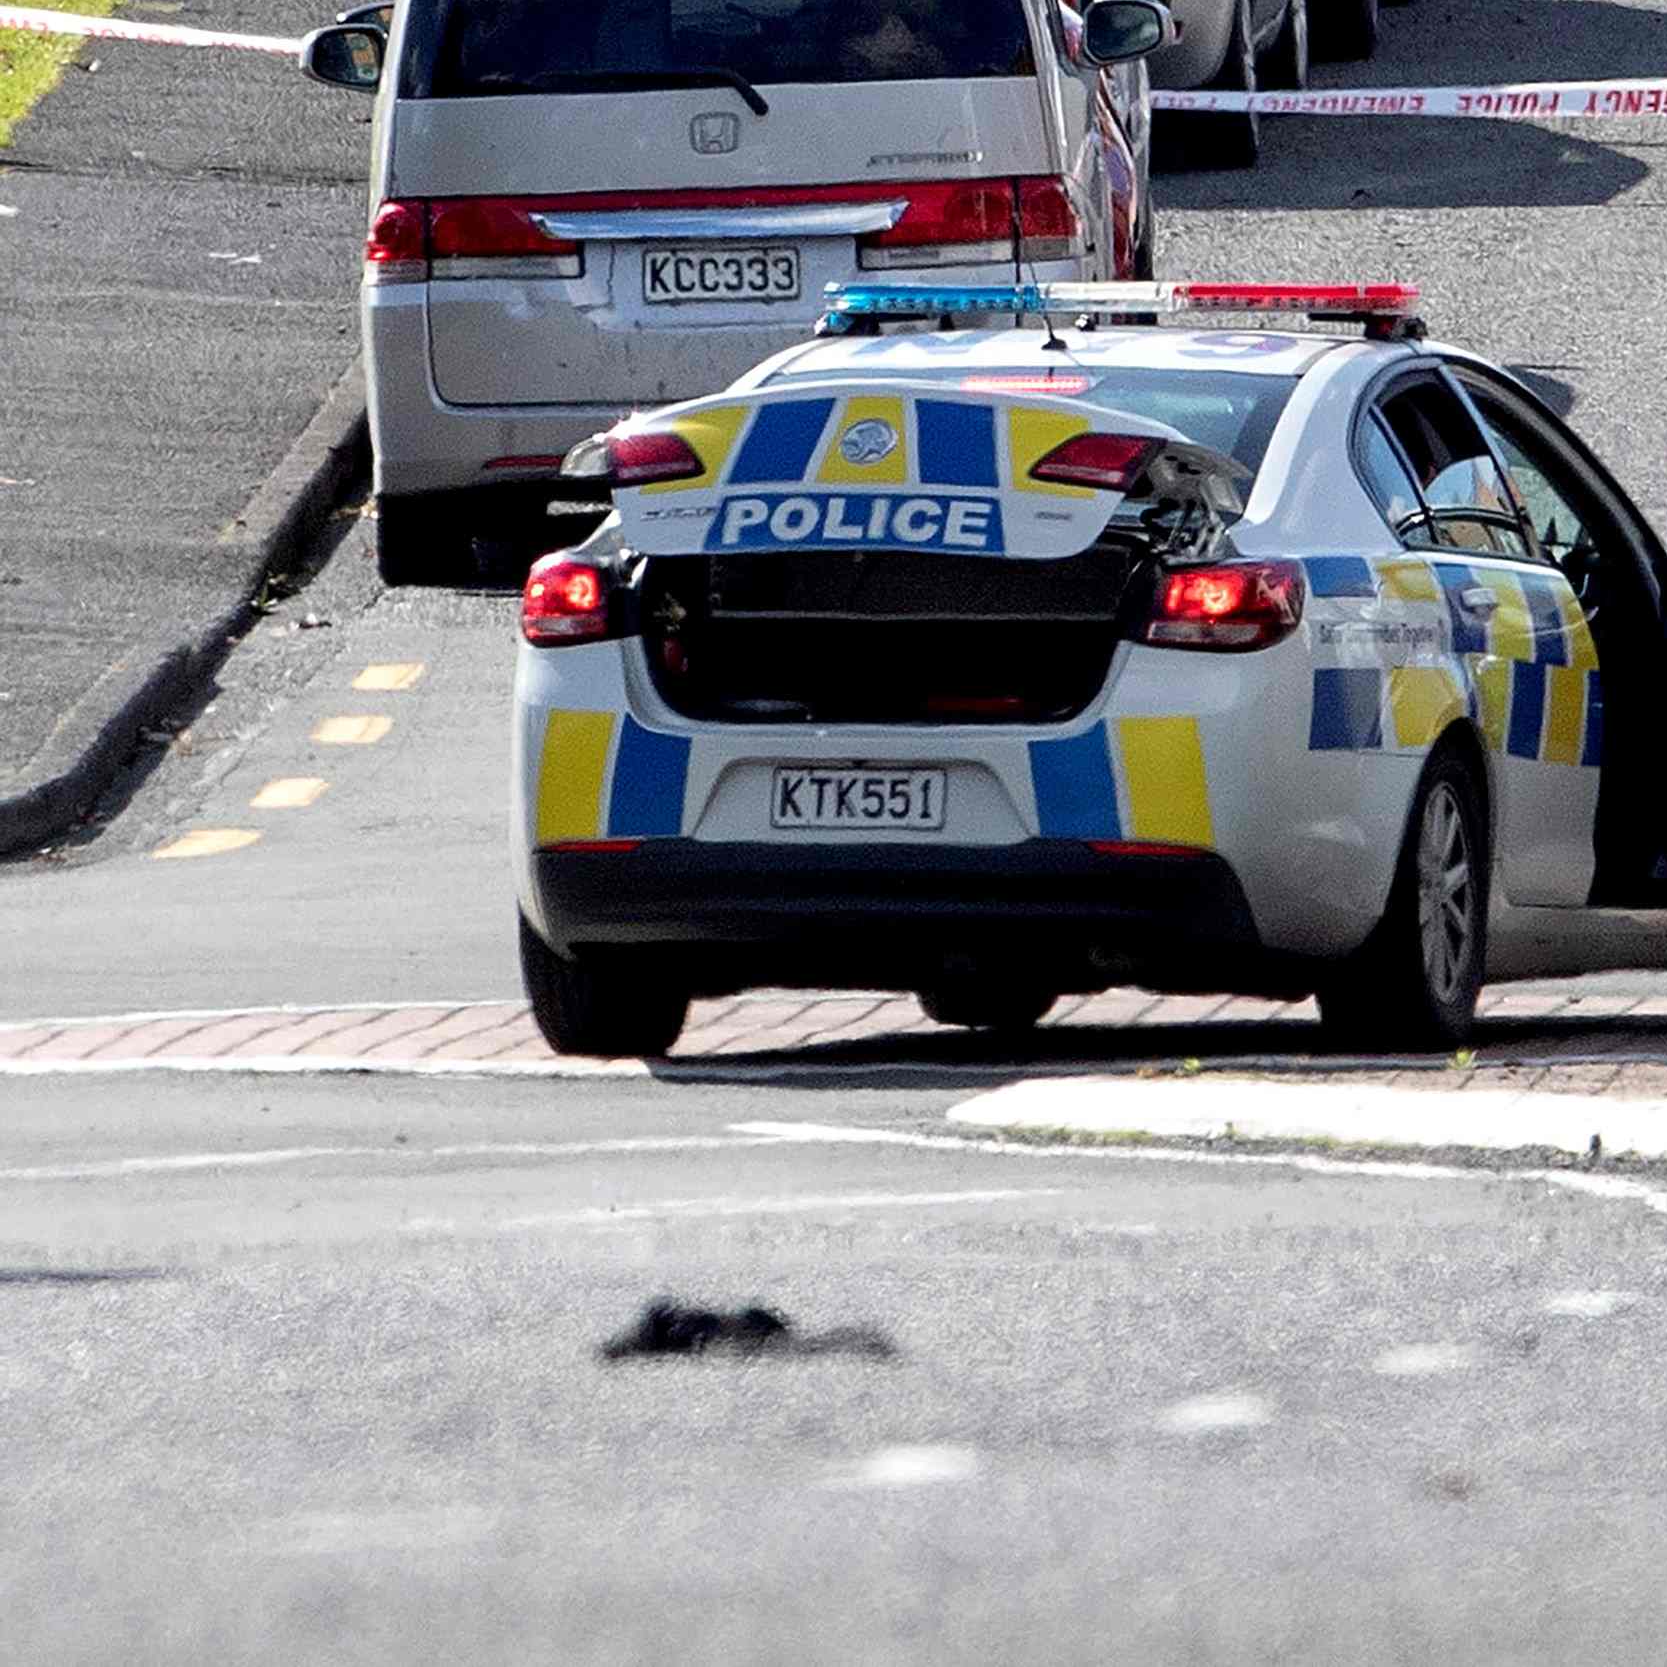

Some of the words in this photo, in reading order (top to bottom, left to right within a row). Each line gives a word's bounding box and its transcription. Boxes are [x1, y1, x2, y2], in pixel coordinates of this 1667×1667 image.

[650, 256, 795, 293] KCC333
[720, 497, 993, 548] POLICE
[779, 777, 932, 819] KTK551
